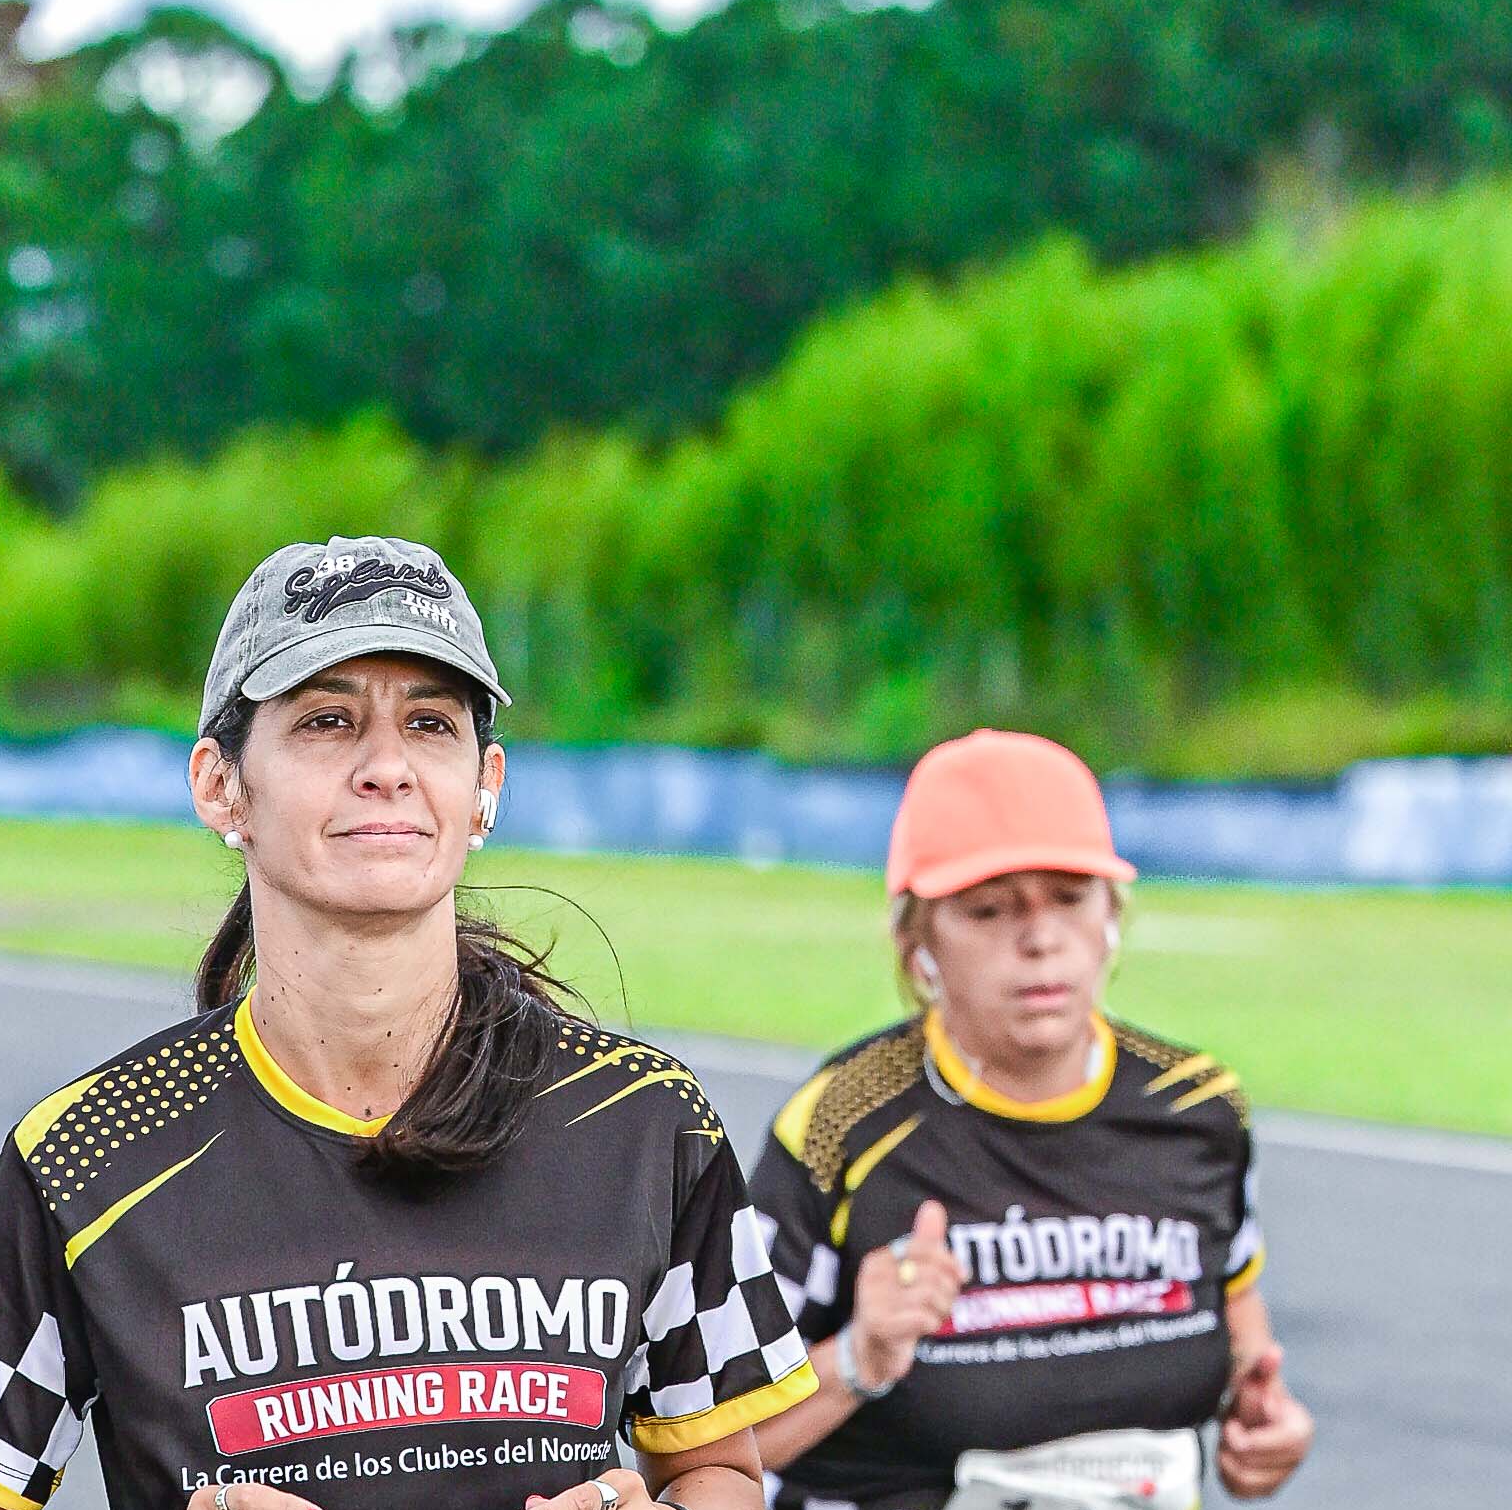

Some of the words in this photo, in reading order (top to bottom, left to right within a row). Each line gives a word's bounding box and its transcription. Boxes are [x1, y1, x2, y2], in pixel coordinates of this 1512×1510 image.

[949, 1204, 1202, 1284] TÓDROMO
[180, 1261, 630, 1389] AUTÓDROMO
[253, 1370, 444, 1443] RUNNING
[458, 1369, 570, 1419] RACE
[181, 1467, 209, 1491] La
[215, 1463, 309, 1485] Carrera
[315, 1454, 348, 1480] de
[354, 1452, 392, 1477] los
[398, 1443, 488, 1473] Clubes
[494, 1437, 534, 1465] del
[540, 1437, 612, 1462] Noroeste
